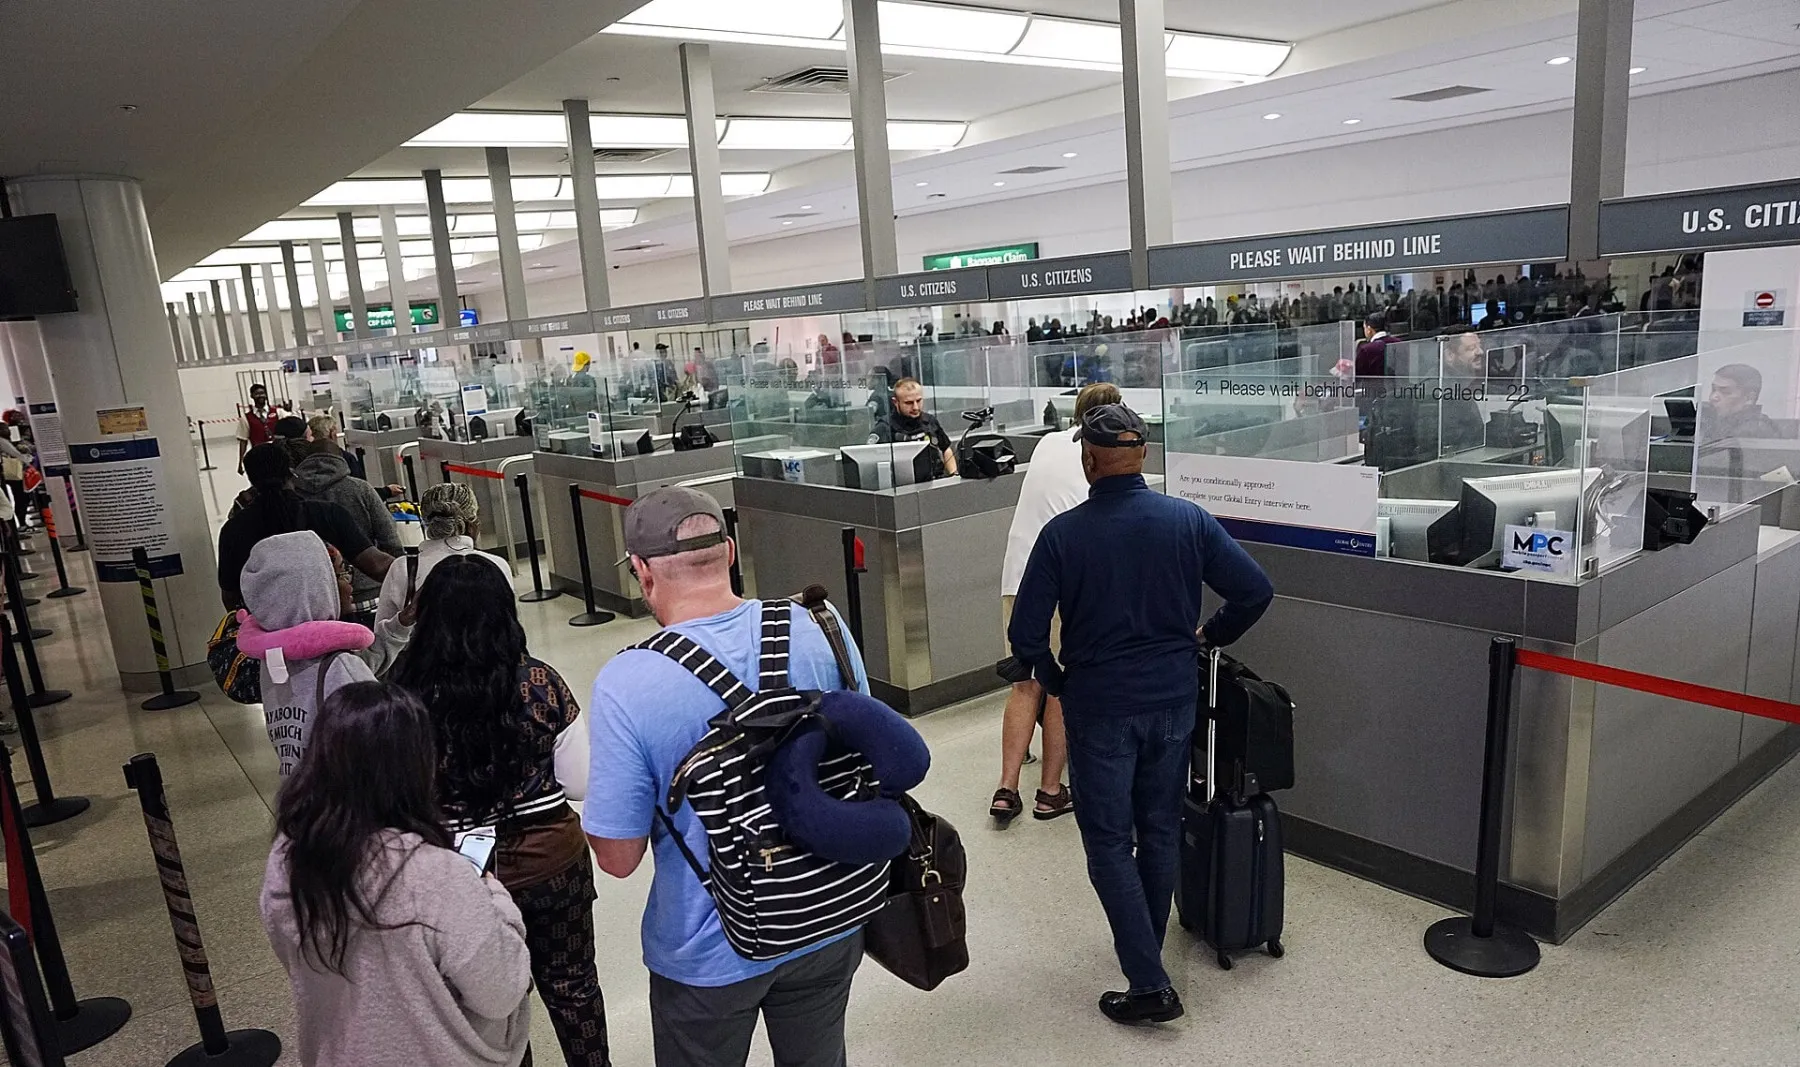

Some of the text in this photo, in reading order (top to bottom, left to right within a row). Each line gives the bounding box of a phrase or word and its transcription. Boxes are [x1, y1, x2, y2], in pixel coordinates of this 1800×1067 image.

[1682, 201, 1800, 233] U.S. CITI
[1003, 251, 1027, 264] Claim
[1230, 234, 1441, 269] PLEASE WAIT BEHIND LINE
[1021, 268, 1092, 288] U.S. CITIZENS
[901, 280, 956, 297] U.S. CITIZENS
[743, 293, 823, 312] PLEASE WAIT BEHIND LINE
[1195, 380, 1208, 395] 21
[1220, 380, 1265, 396] Please
[1270, 381, 1300, 397] wait
[1304, 381, 1355, 398] behind
[1393, 383, 1425, 400] until
[1432, 383, 1489, 402] called.
[1506, 384, 1530, 402] 22
[1203, 477, 1241, 489] conditionally
[1244, 481, 1275, 491] approved?
[1180, 490, 1206, 500] Complete
[1224, 494, 1242, 504] Global
[1244, 496, 1261, 507] Entry
[1263, 500, 1294, 509] interview
[1295, 502, 1312, 511] here.
[1513, 531, 1564, 556] MPC
[274, 706, 308, 724] ABOUT
[274, 724, 302, 742] MUCH
